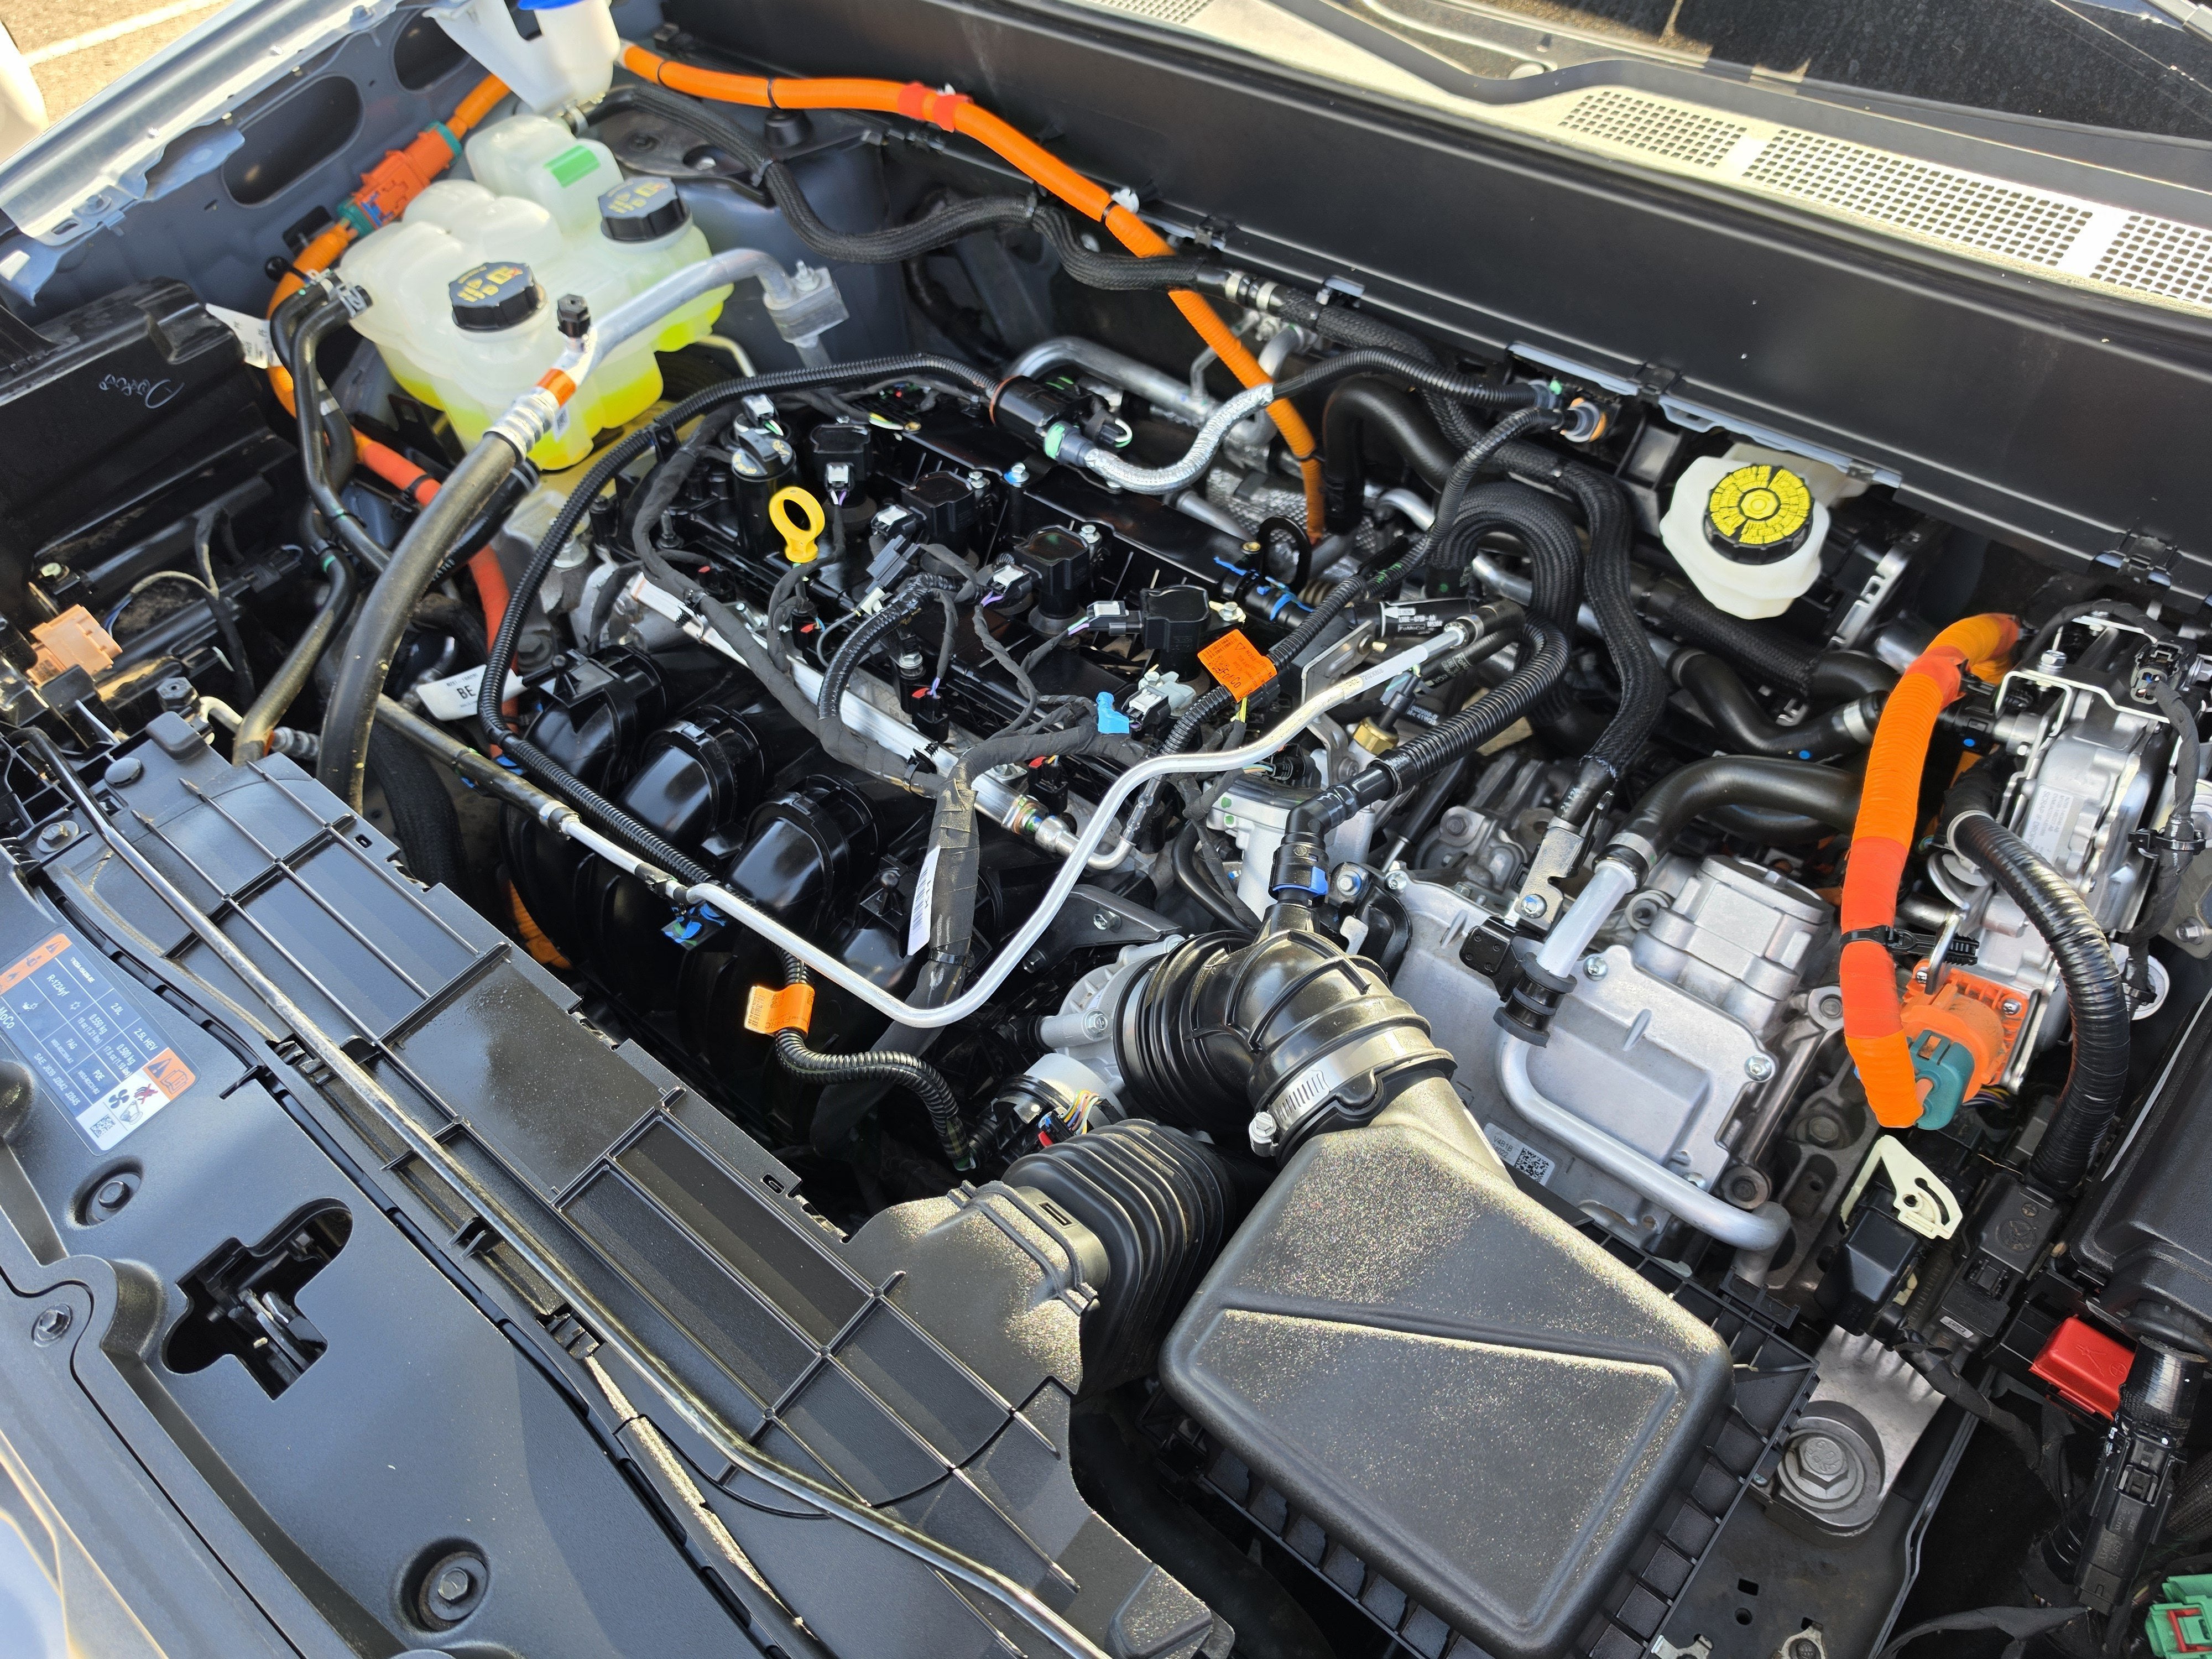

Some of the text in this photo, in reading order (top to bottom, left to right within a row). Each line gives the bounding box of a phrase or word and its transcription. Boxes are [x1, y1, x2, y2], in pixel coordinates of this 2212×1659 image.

[457, 686, 476, 700] BE
[2038, 790, 2050, 813] SCRAP
[46, 974, 70, 997] R-1234yf
[110, 1003, 124, 1016] 2.0L
[88, 1013, 103, 1027] 0.550
[65, 1038, 77, 1050] PAG
[134, 1028, 158, 1051] 2.5L HEV
[116, 1044, 131, 1058] 0.500
[34, 1052, 81, 1106] SAE J639 J2842 J2845
[93, 1070, 105, 1081] POE
